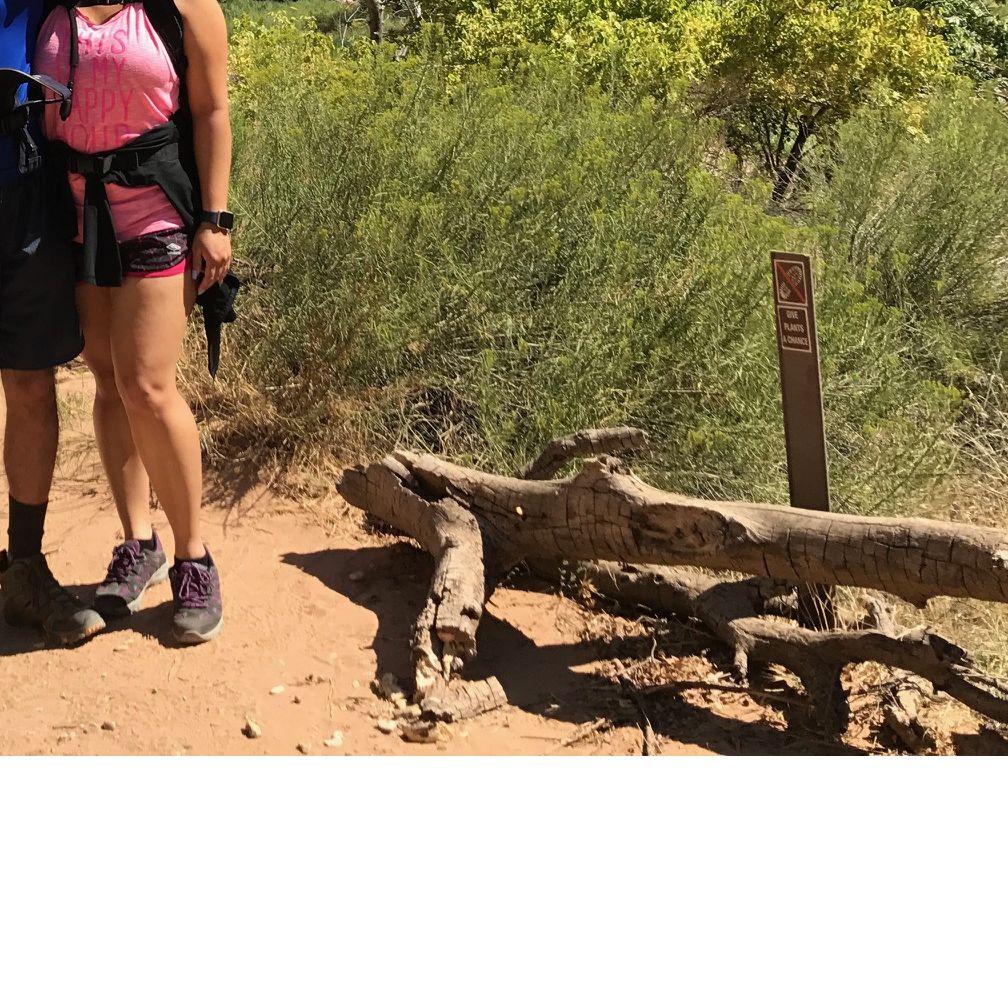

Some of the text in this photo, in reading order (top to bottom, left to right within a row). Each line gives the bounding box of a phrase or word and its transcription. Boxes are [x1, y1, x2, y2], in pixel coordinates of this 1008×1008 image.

[92, 57, 127, 84] MY
[71, 88, 134, 123] APPY
[786, 310, 799, 320] GIVE
[783, 322, 804, 333] PLANTS
[787, 336, 808, 346] CHANCE
